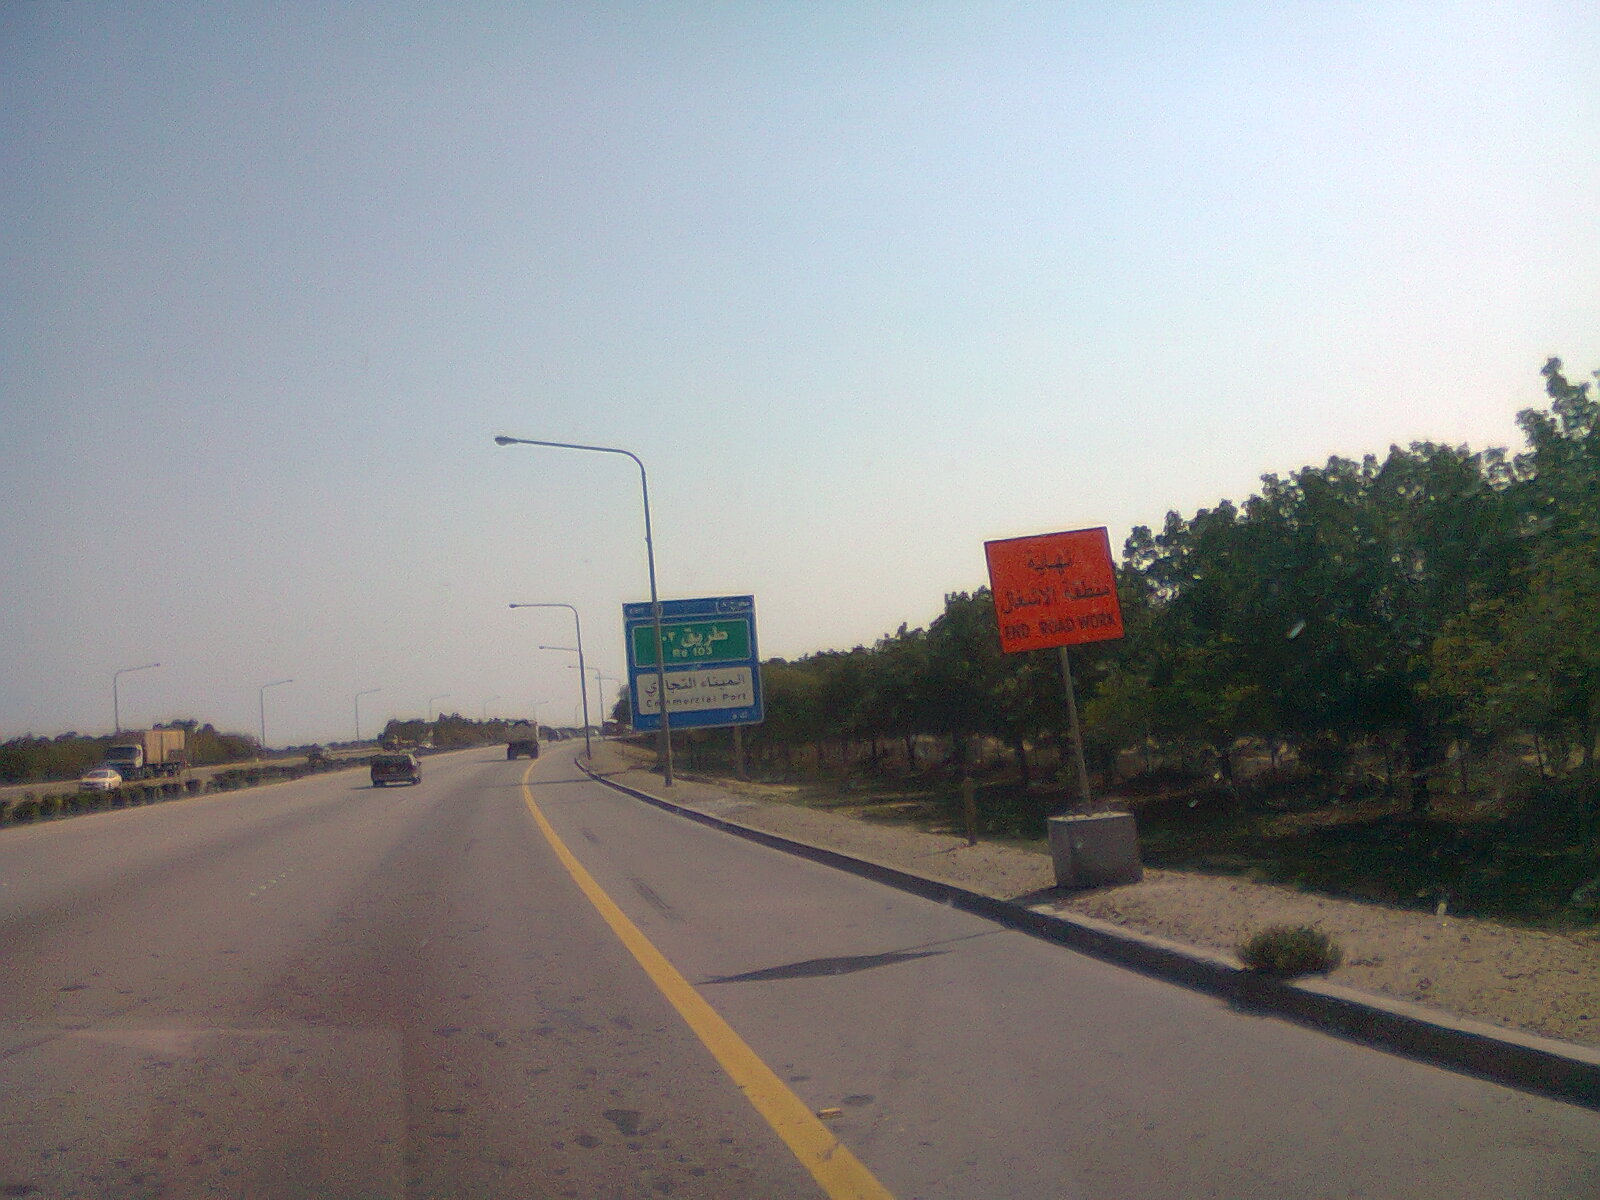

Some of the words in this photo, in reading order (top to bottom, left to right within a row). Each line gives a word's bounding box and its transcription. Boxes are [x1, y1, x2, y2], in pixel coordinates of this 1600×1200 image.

[1005, 623, 1030, 640] END
[1039, 618, 1075, 635] ROAD
[1077, 613, 1115, 630] WORK
[722, 693, 747, 701] Port
